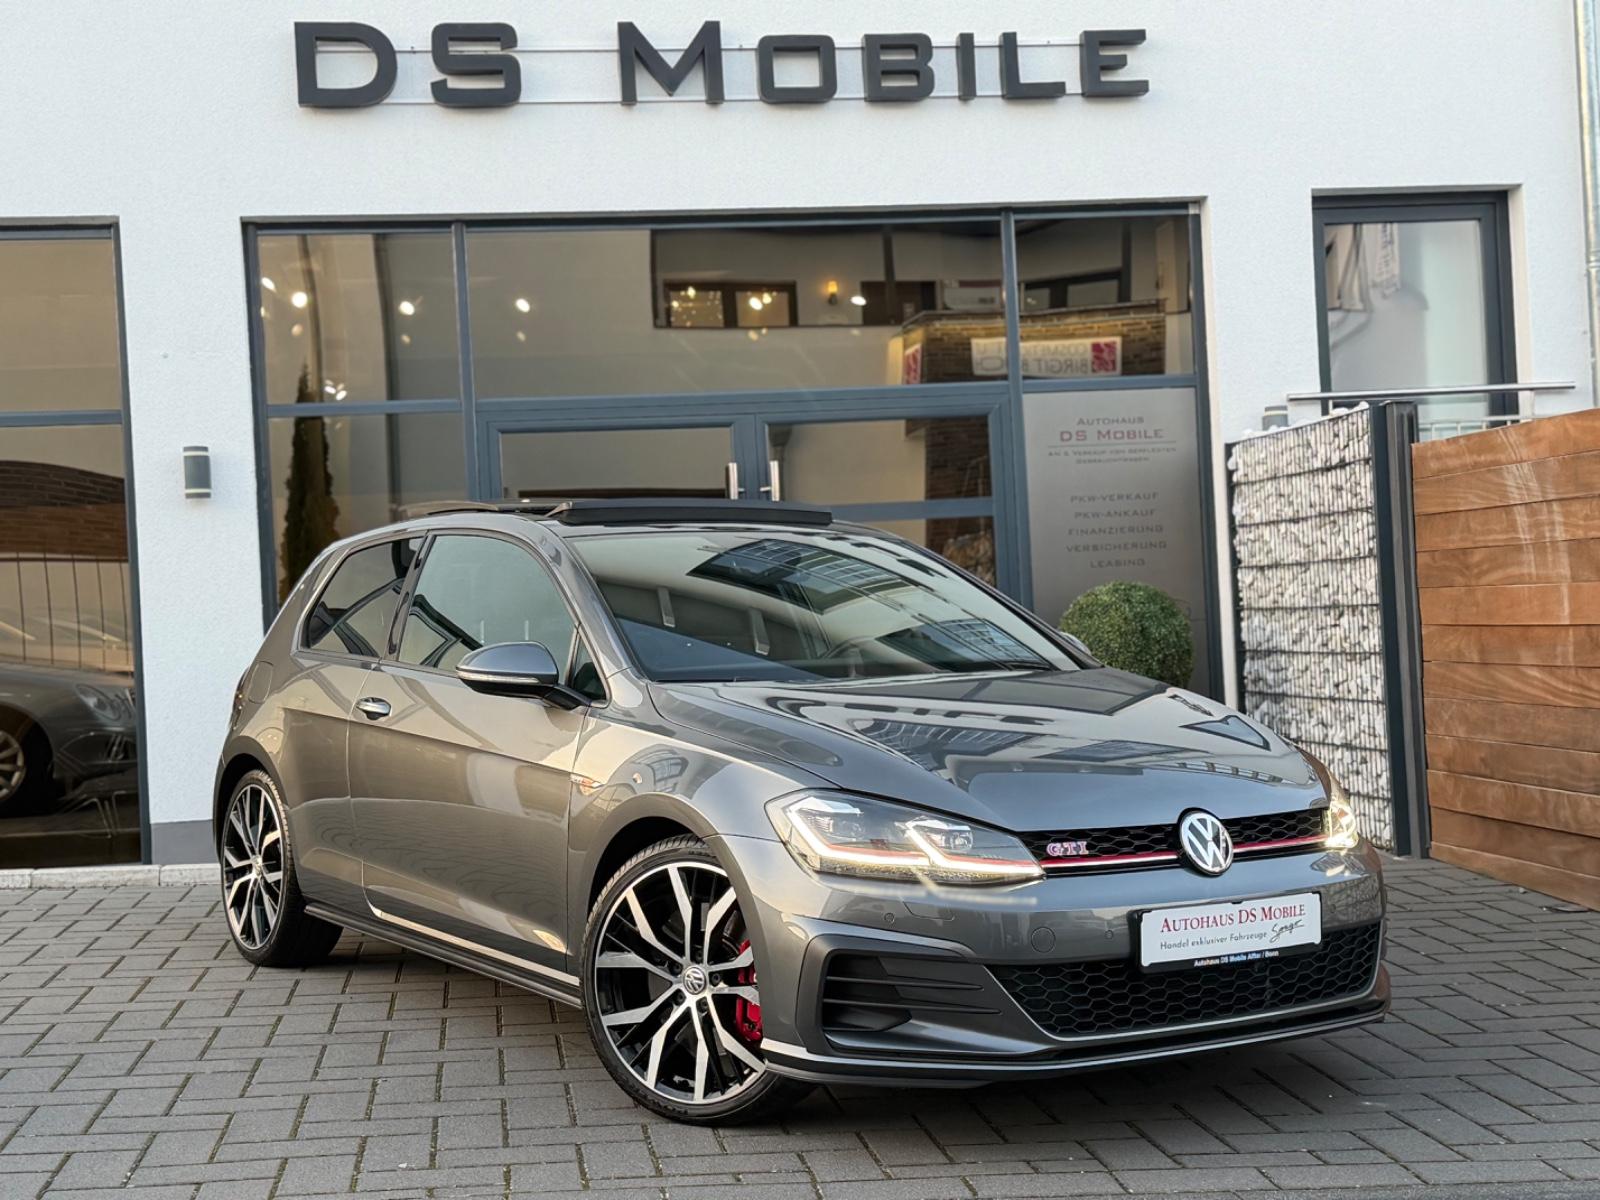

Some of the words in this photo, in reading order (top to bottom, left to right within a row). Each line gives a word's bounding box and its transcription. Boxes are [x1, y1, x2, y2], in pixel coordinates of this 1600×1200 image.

[294, 22, 521, 108] DS
[617, 20, 1149, 105] MOBILE
[1077, 416, 1145, 426] AUTOHAUS
[1060, 430, 1088, 442] DS
[1097, 429, 1164, 441] MOBILE
[1070, 492, 1159, 503] PKW-VERKAUF
[1074, 509, 1156, 519] PKW-ANKAUF
[1068, 525, 1164, 536] FINANZIERUNG
[1066, 541, 1167, 552] VERSICHERUNG
[1090, 558, 1146, 569] LEASING
[1046, 841, 1089, 856] GTI
[1160, 913, 1235, 933] AUTOHAUS
[1238, 908, 1257, 924] DS
[1261, 904, 1306, 922] MOBILE
[1160, 937, 1190, 950] Handel
[1191, 932, 1228, 946] exklusiver
[1230, 931, 1267, 942] Fahrzeuge
[1194, 958, 1220, 967] Autohaus
